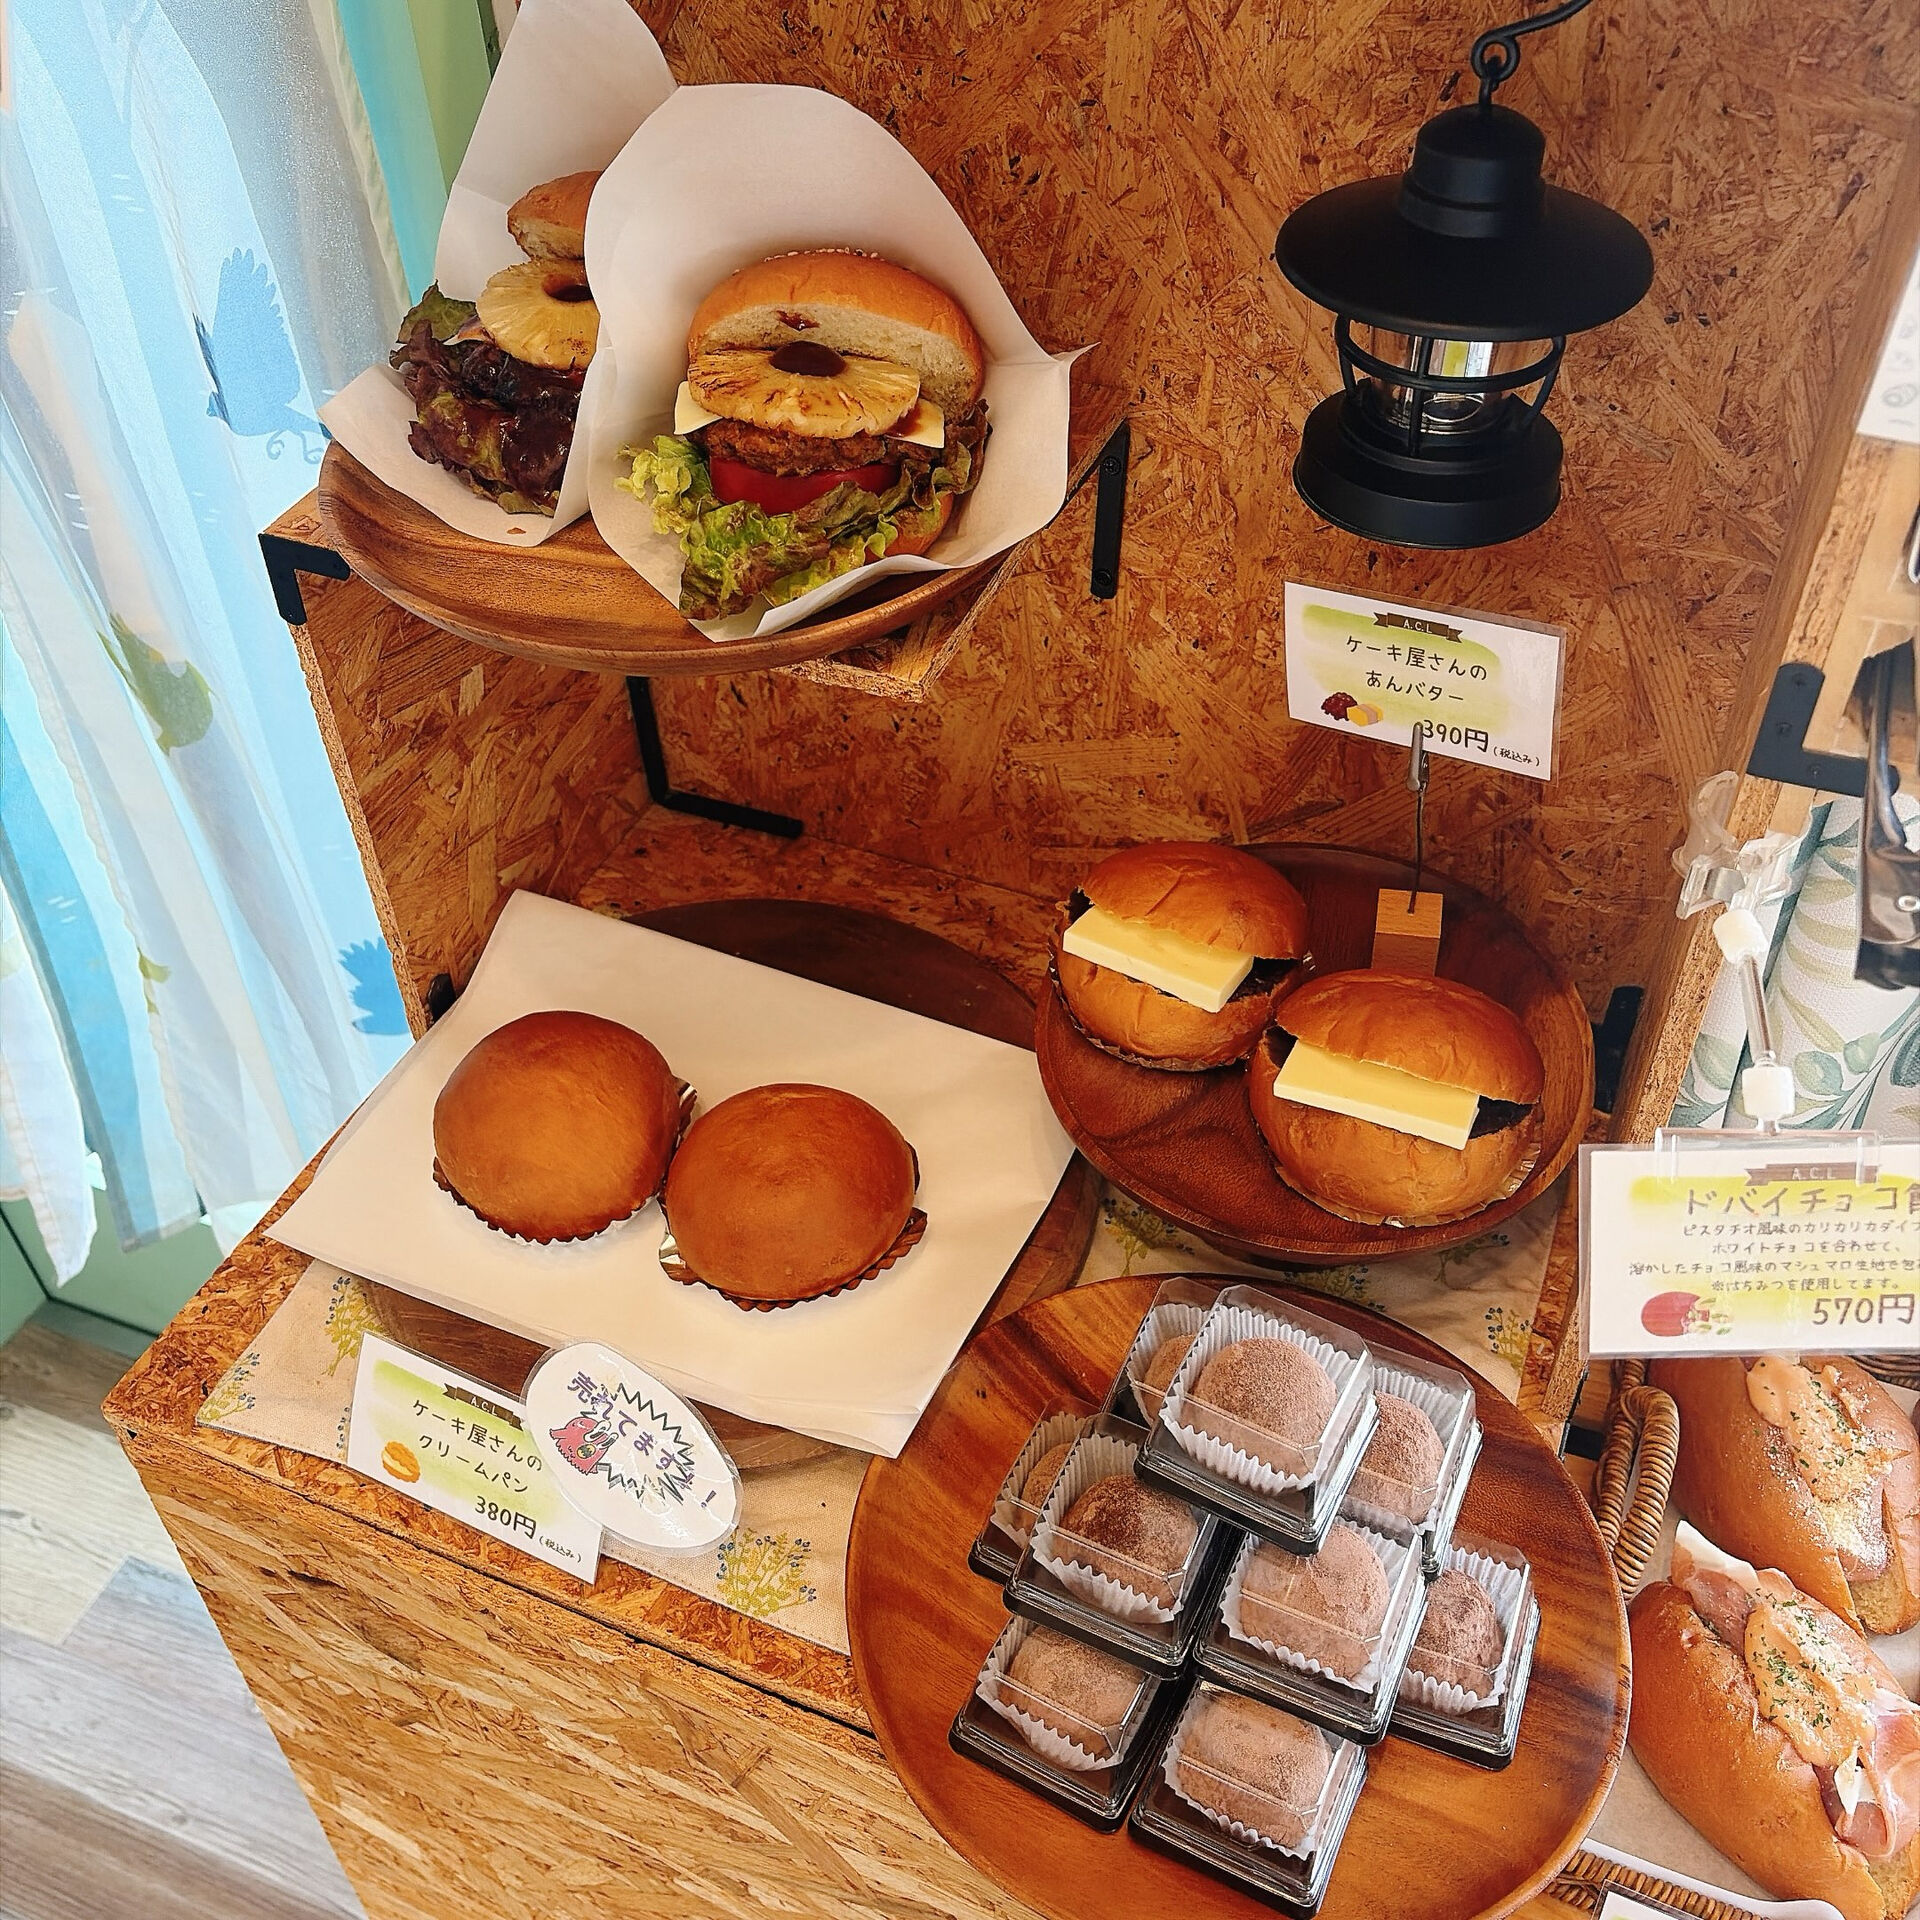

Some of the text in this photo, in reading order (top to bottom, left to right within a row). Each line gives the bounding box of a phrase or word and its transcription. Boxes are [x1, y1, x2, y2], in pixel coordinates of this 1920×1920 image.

[1345, 635, 1487, 681] ケーキ屋さんの
[1365, 670, 1464, 702] あんバター
[1422, 719, 1489, 753] 390円
[1628, 1259, 1920, 1276] 溶かしたチョコ風味のマシュマロ生地で包
[1811, 1293, 1915, 1326] 570円
[412, 1399, 543, 1472] ケーキ屋さんの
[418, 1434, 529, 1493] クリームパン
[474, 1495, 537, 1540] 380円
